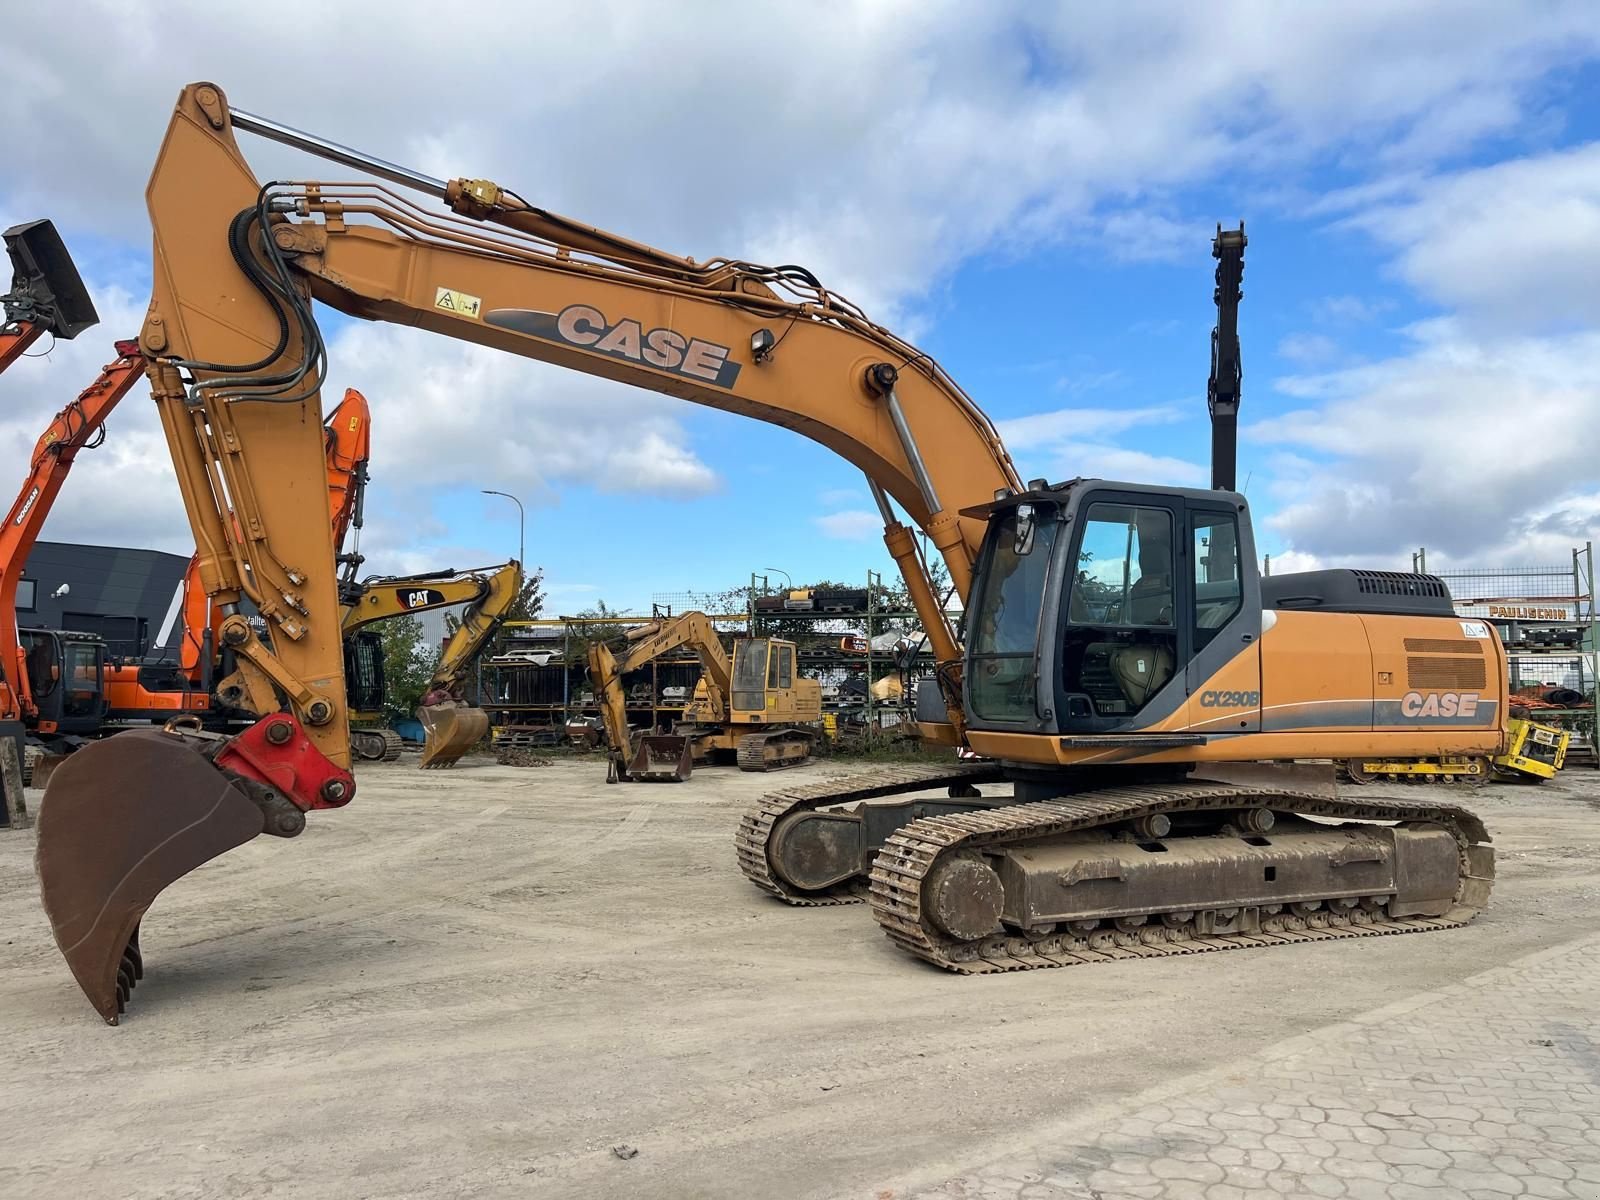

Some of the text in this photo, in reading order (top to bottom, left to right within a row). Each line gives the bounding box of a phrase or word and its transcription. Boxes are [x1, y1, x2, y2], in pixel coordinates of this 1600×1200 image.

[556, 304, 730, 381] CASE
[16, 487, 39, 525] DOOSAN
[408, 590, 429, 608] CAT
[1200, 690, 1260, 708] CX290B
[1401, 691, 1479, 718] CASE
